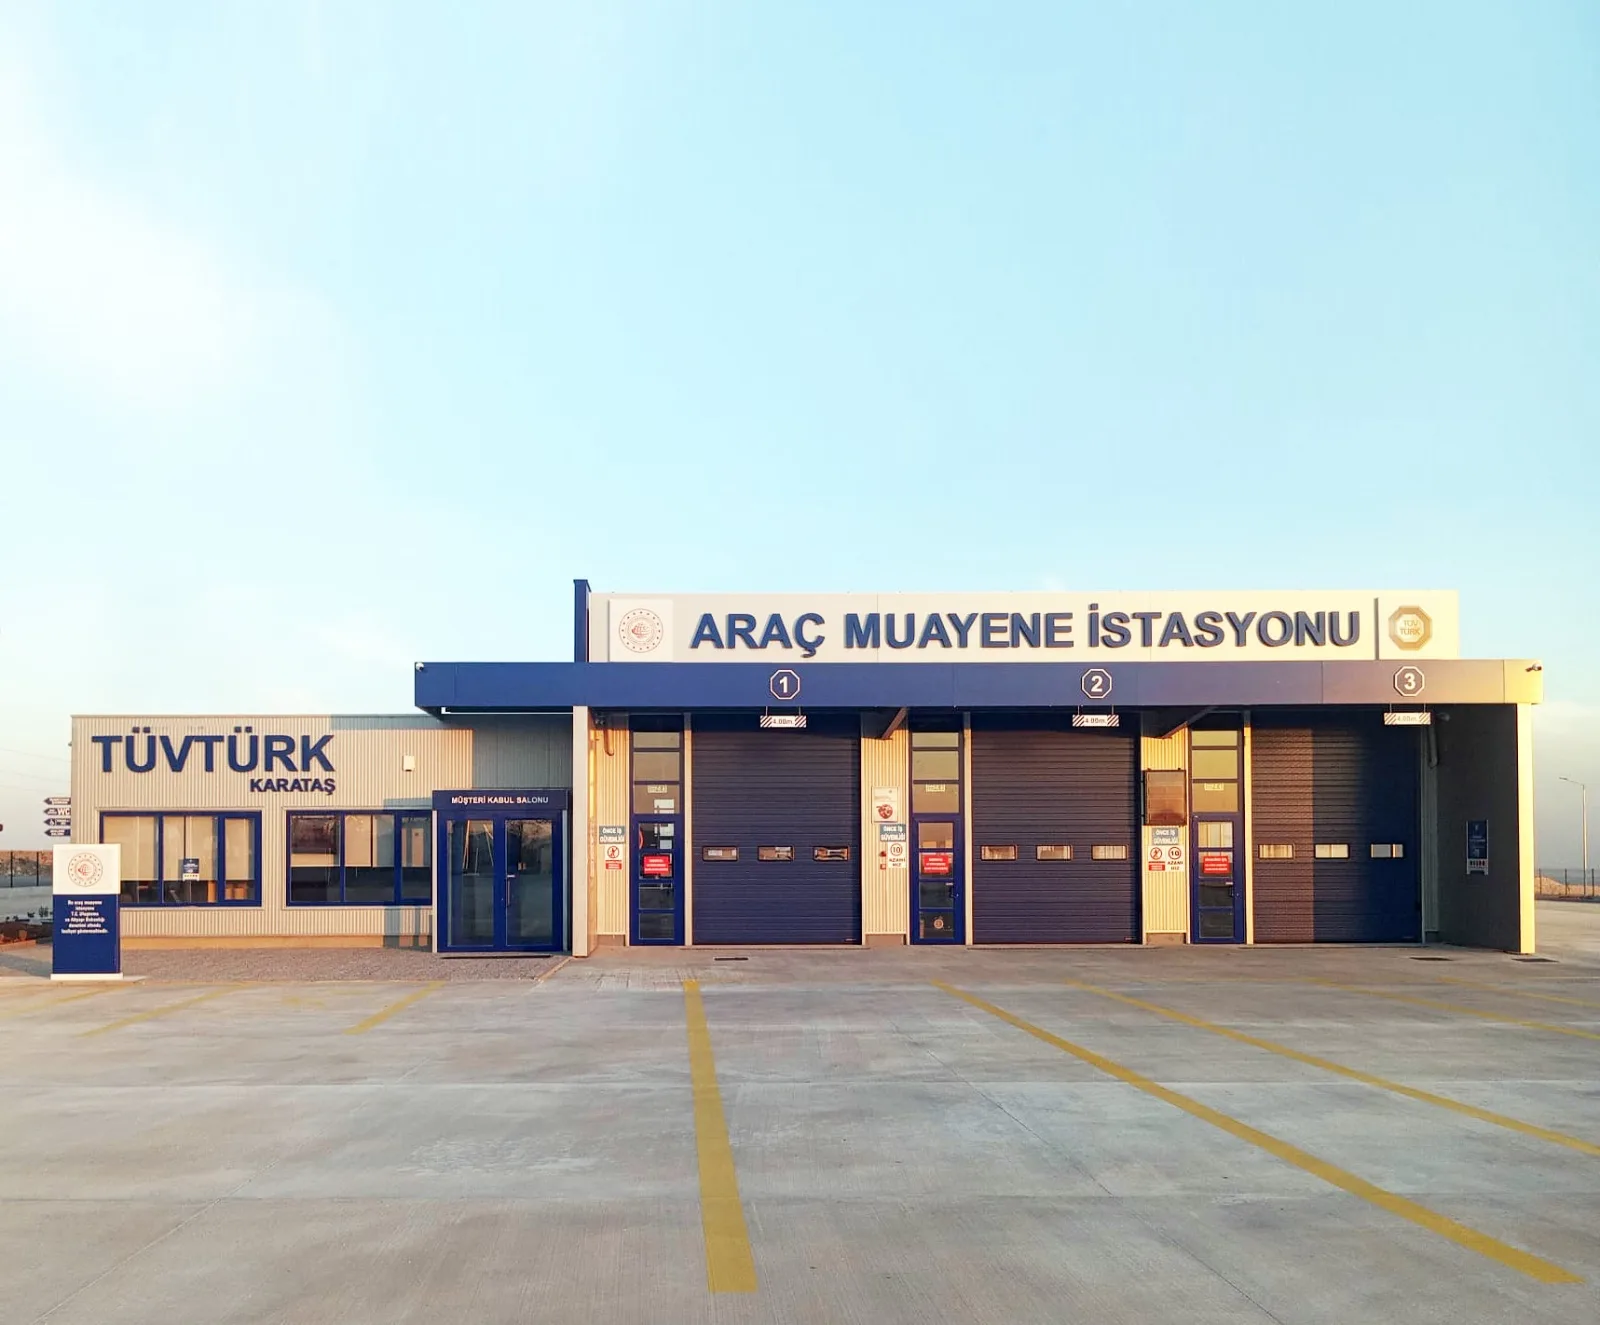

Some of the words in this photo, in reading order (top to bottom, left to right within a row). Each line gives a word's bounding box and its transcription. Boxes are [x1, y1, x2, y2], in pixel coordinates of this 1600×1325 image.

[689, 612, 826, 658] ARAÇ
[844, 612, 1074, 648] MUAYENE
[1088, 603, 1360, 648] İSTASYONU
[779, 675, 788, 694] 1
[1091, 675, 1103, 692] 2
[1404, 672, 1416, 690] 3
[91, 726, 336, 773] TÜVTÜRK
[249, 778, 336, 796] KARATAŞ
[451, 795, 486, 805] MÜŞTERİ
[487, 796, 514, 804] KABUL
[516, 796, 549, 804] SALONU
